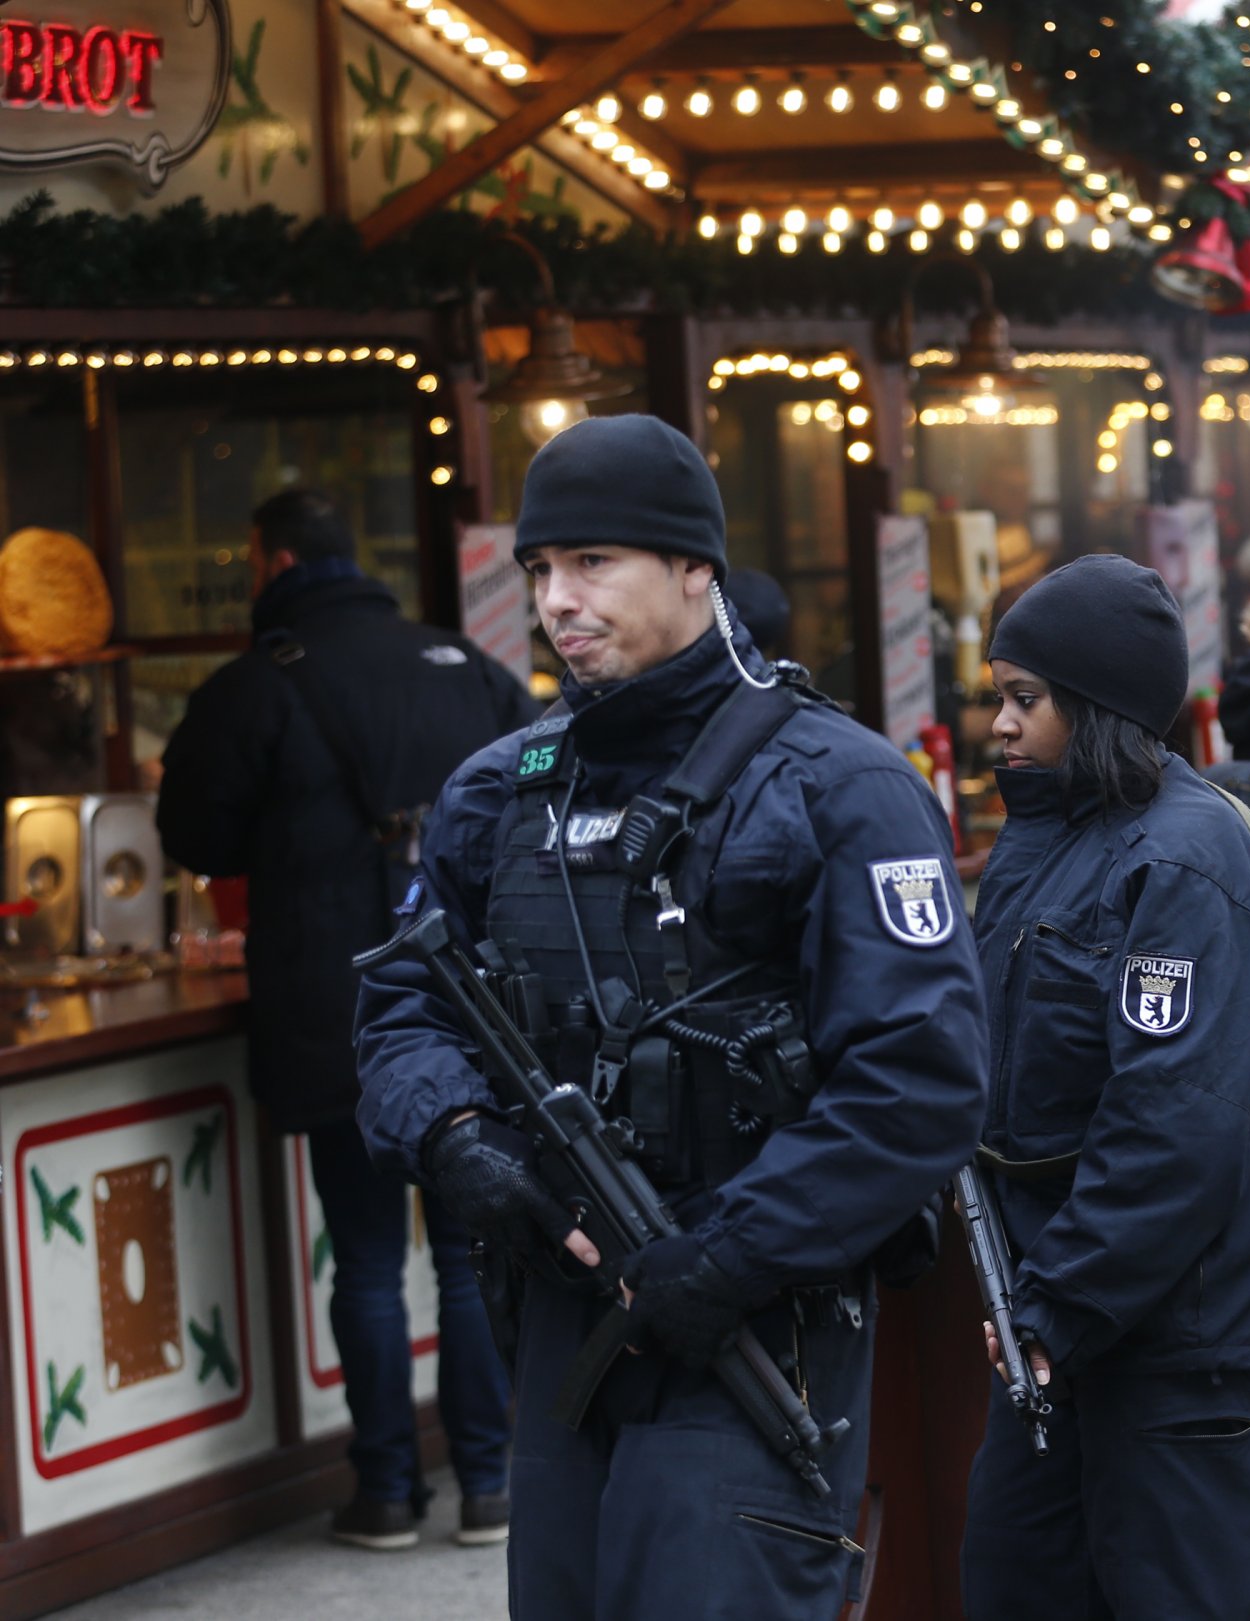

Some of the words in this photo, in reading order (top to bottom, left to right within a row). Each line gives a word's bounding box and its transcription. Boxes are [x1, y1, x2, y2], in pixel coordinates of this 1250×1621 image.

[0, 19, 164, 119] BROT
[520, 745, 557, 775] 35
[1130, 959, 1188, 978] POLIZEI
